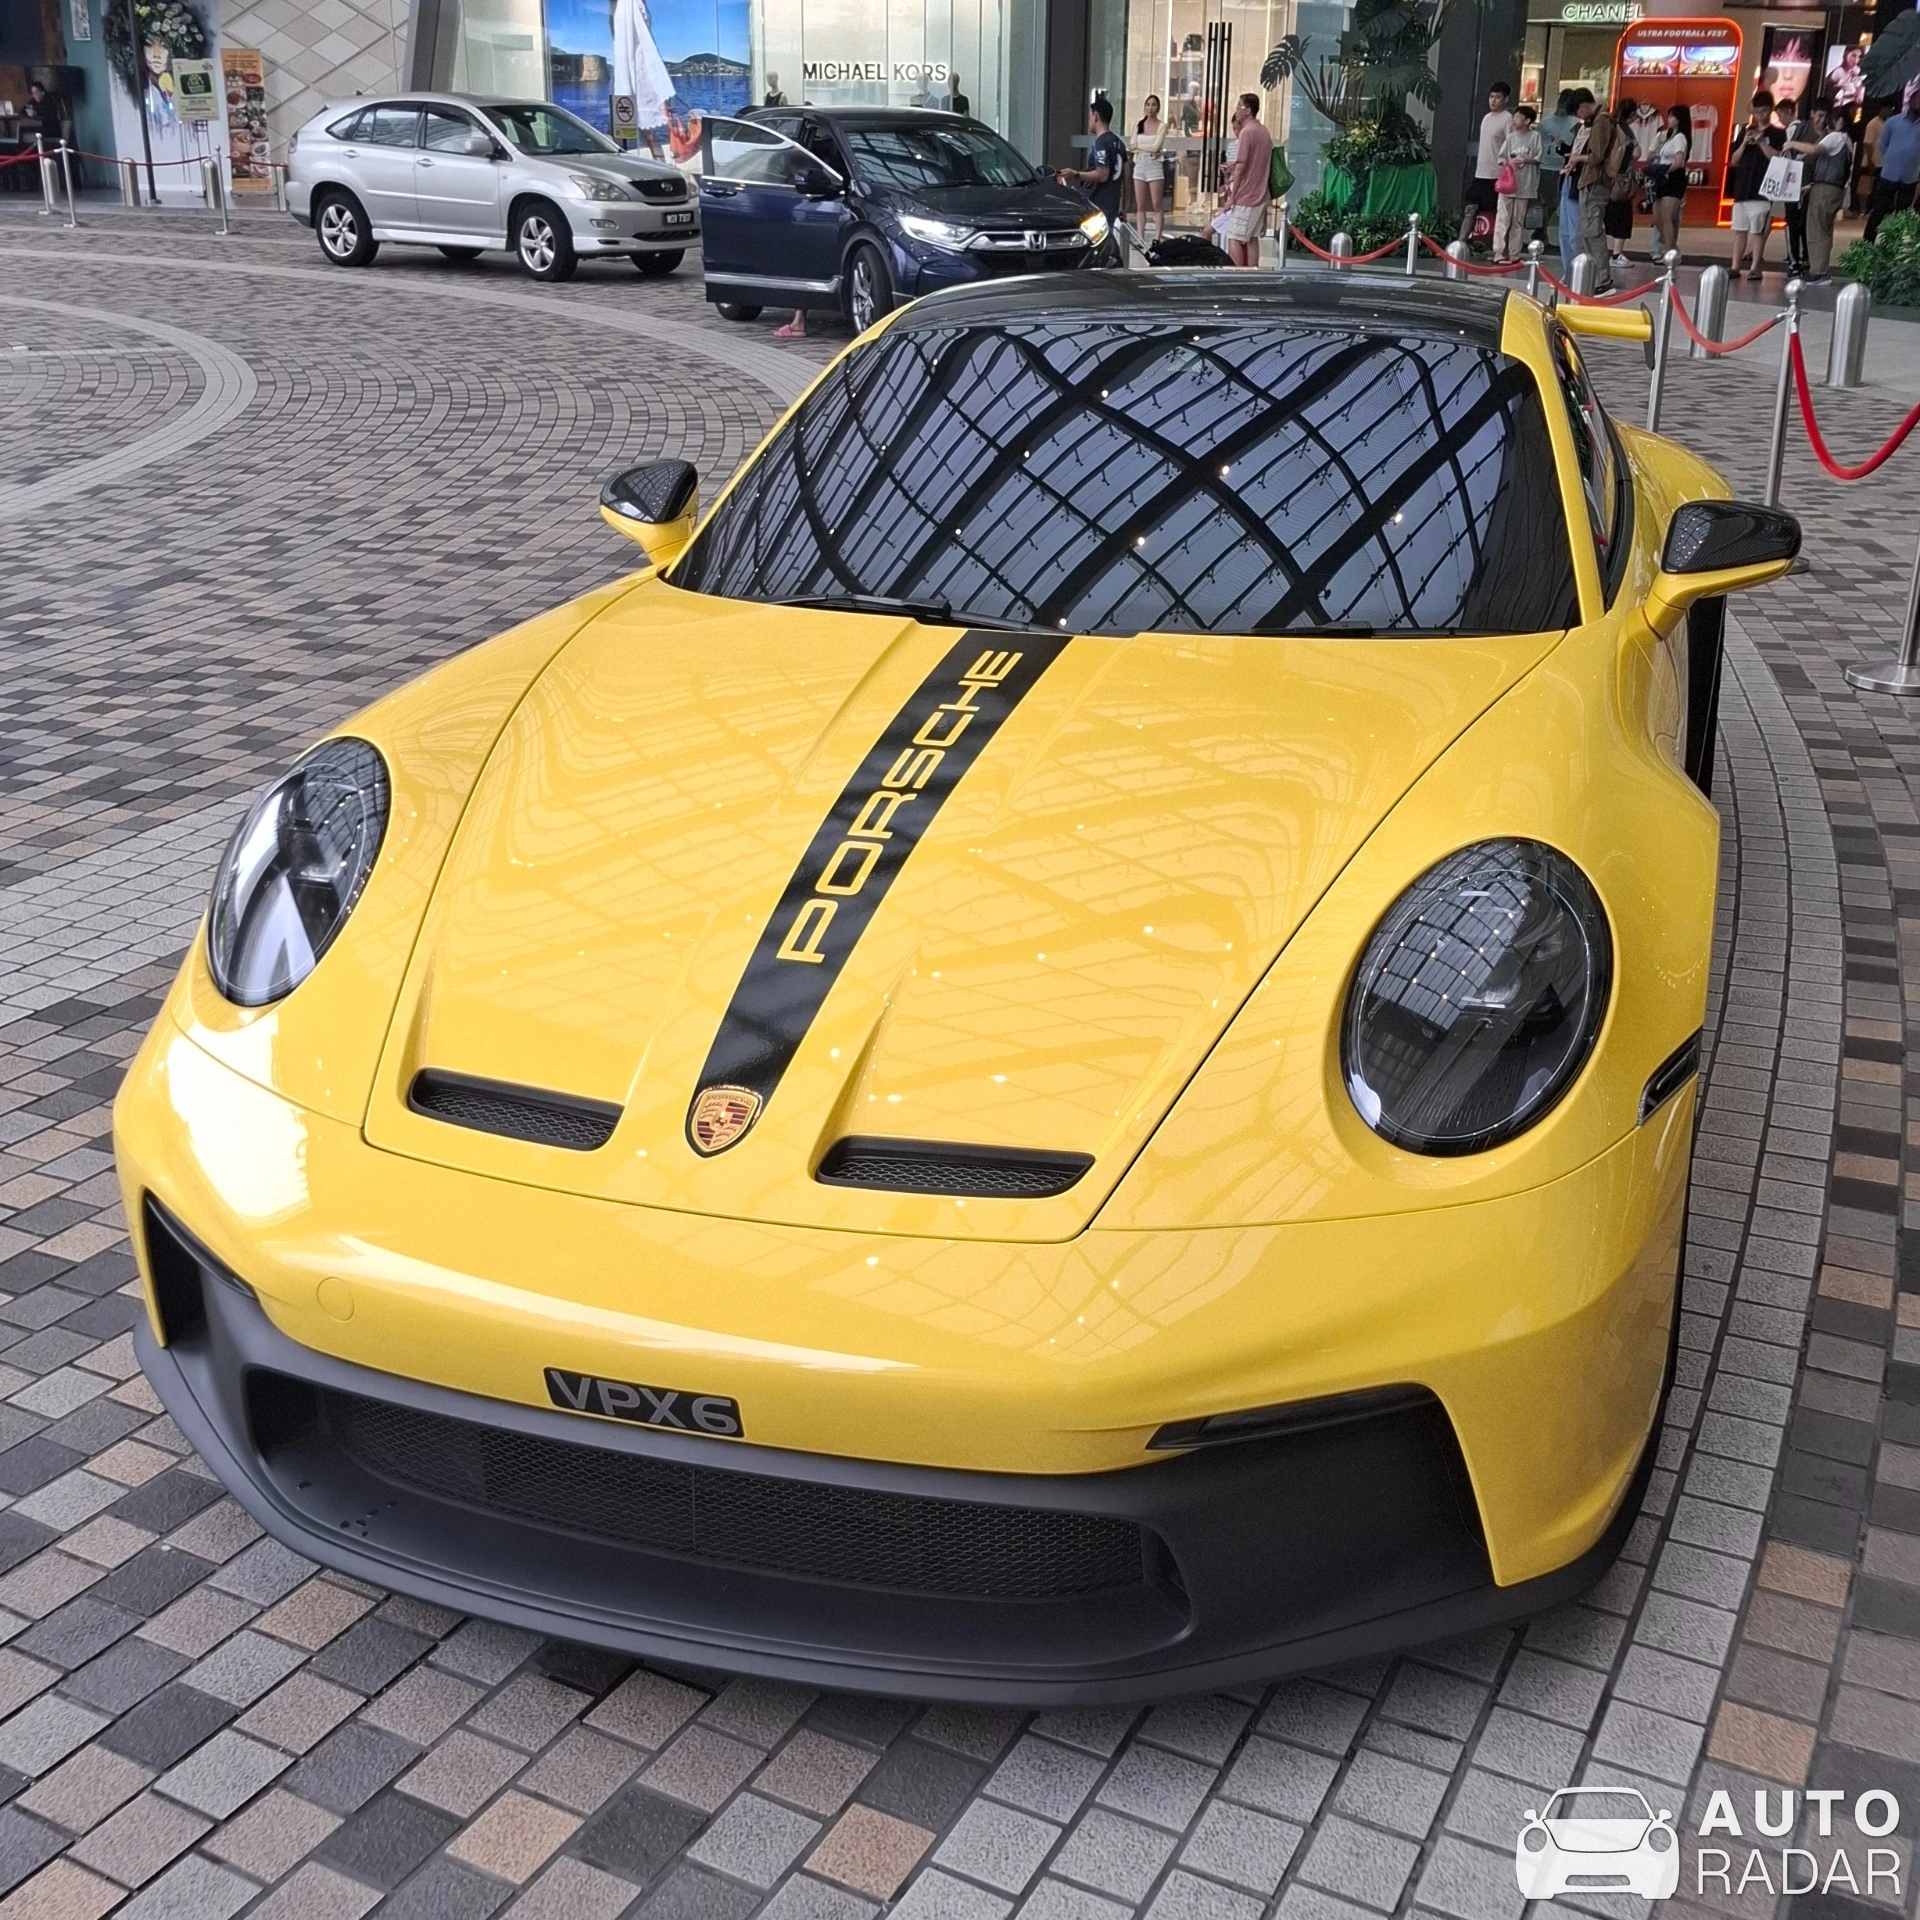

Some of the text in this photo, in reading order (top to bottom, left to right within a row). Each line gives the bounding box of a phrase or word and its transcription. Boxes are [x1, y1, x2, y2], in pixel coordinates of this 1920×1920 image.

[1563, 4, 1646, 19] CHANEL
[803, 62, 946, 81] MICHAEL KORS
[776, 650, 1024, 963] PORSCHE
[550, 1370, 738, 1434] VPX 6
